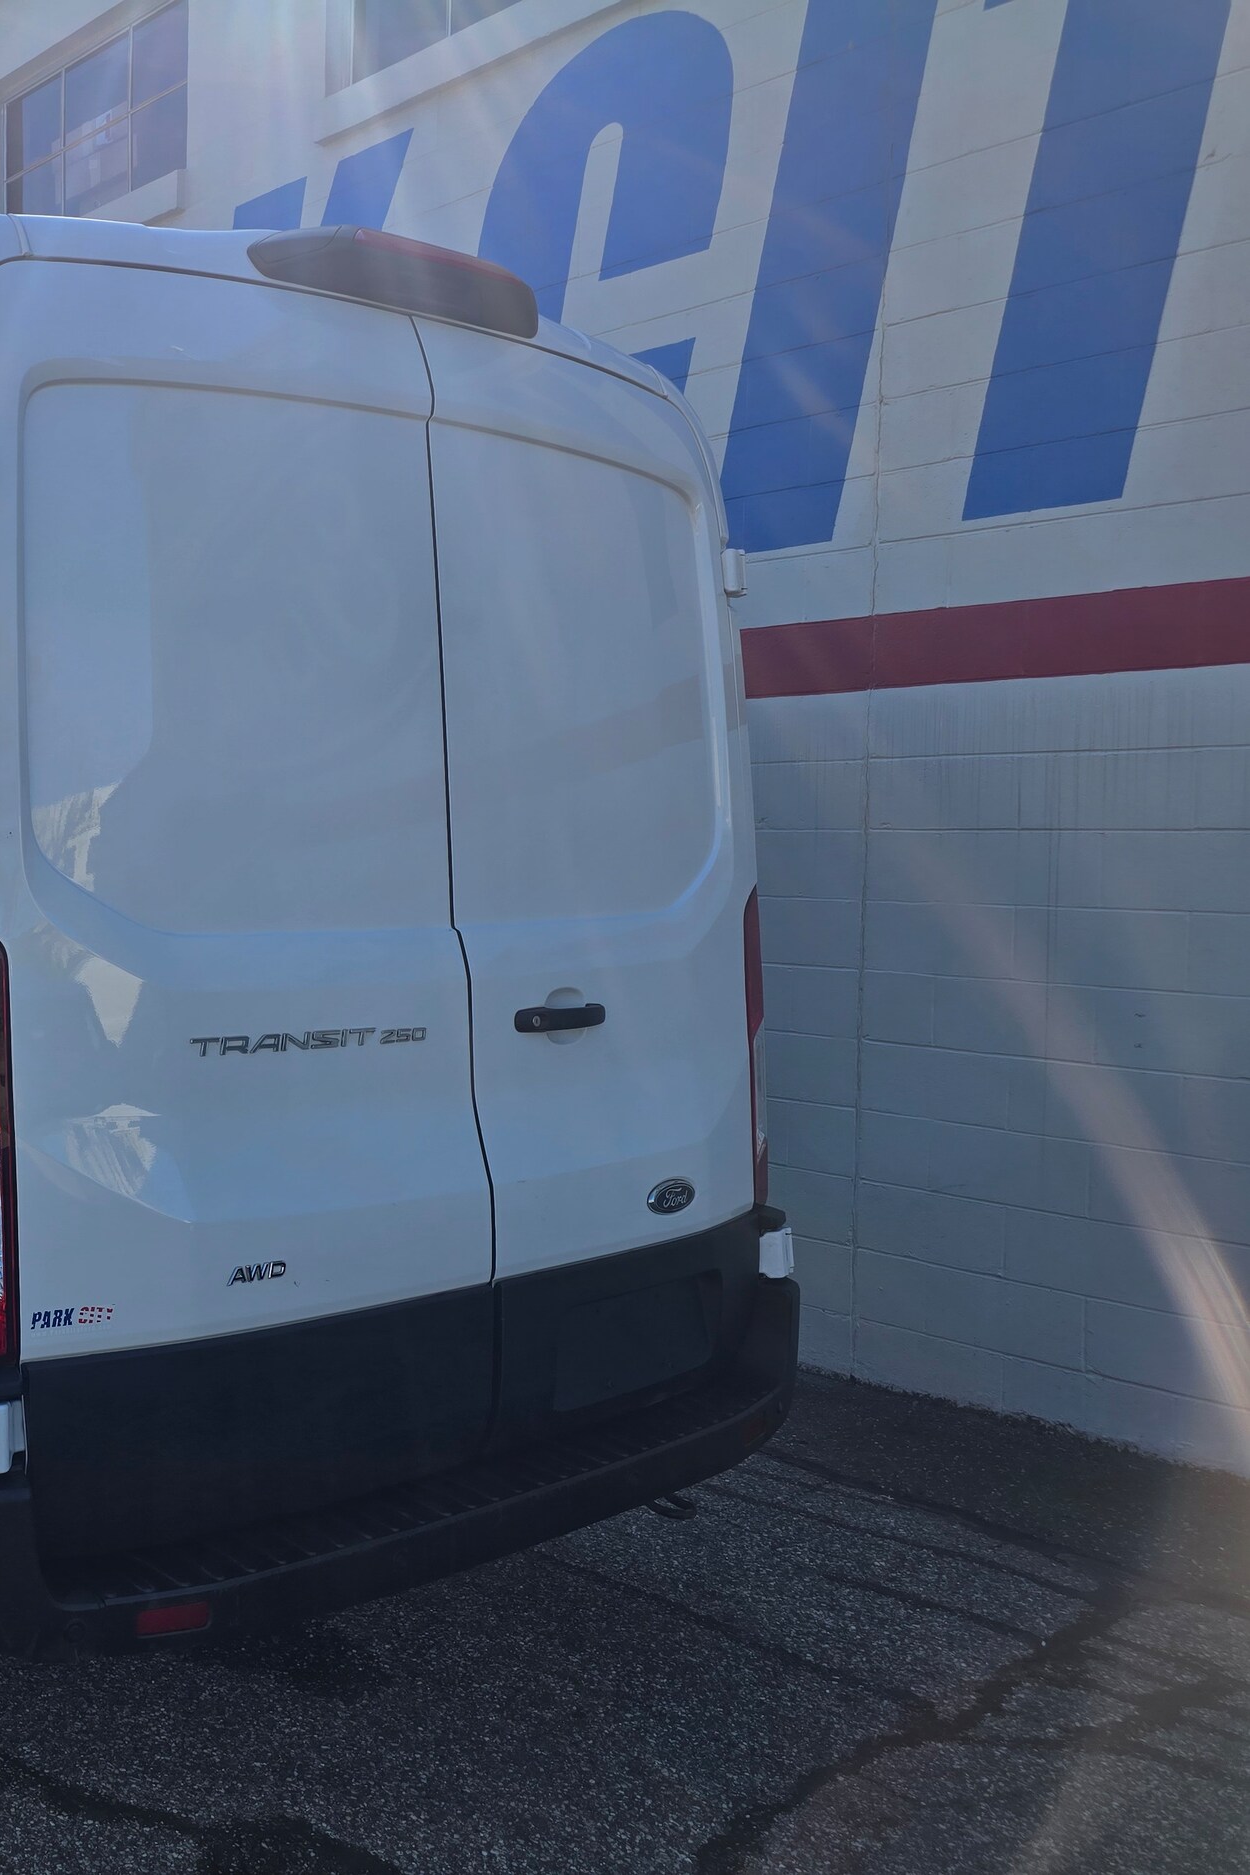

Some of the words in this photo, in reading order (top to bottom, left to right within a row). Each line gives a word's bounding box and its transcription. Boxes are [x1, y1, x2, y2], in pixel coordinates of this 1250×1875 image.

[190, 1027, 376, 1057] TRANSIT
[380, 1027, 427, 1044] 250
[663, 1187, 688, 1208] Ford
[227, 1260, 286, 1287] AWD
[31, 1307, 74, 1329] PARK
[78, 1306, 113, 1324] CITY
